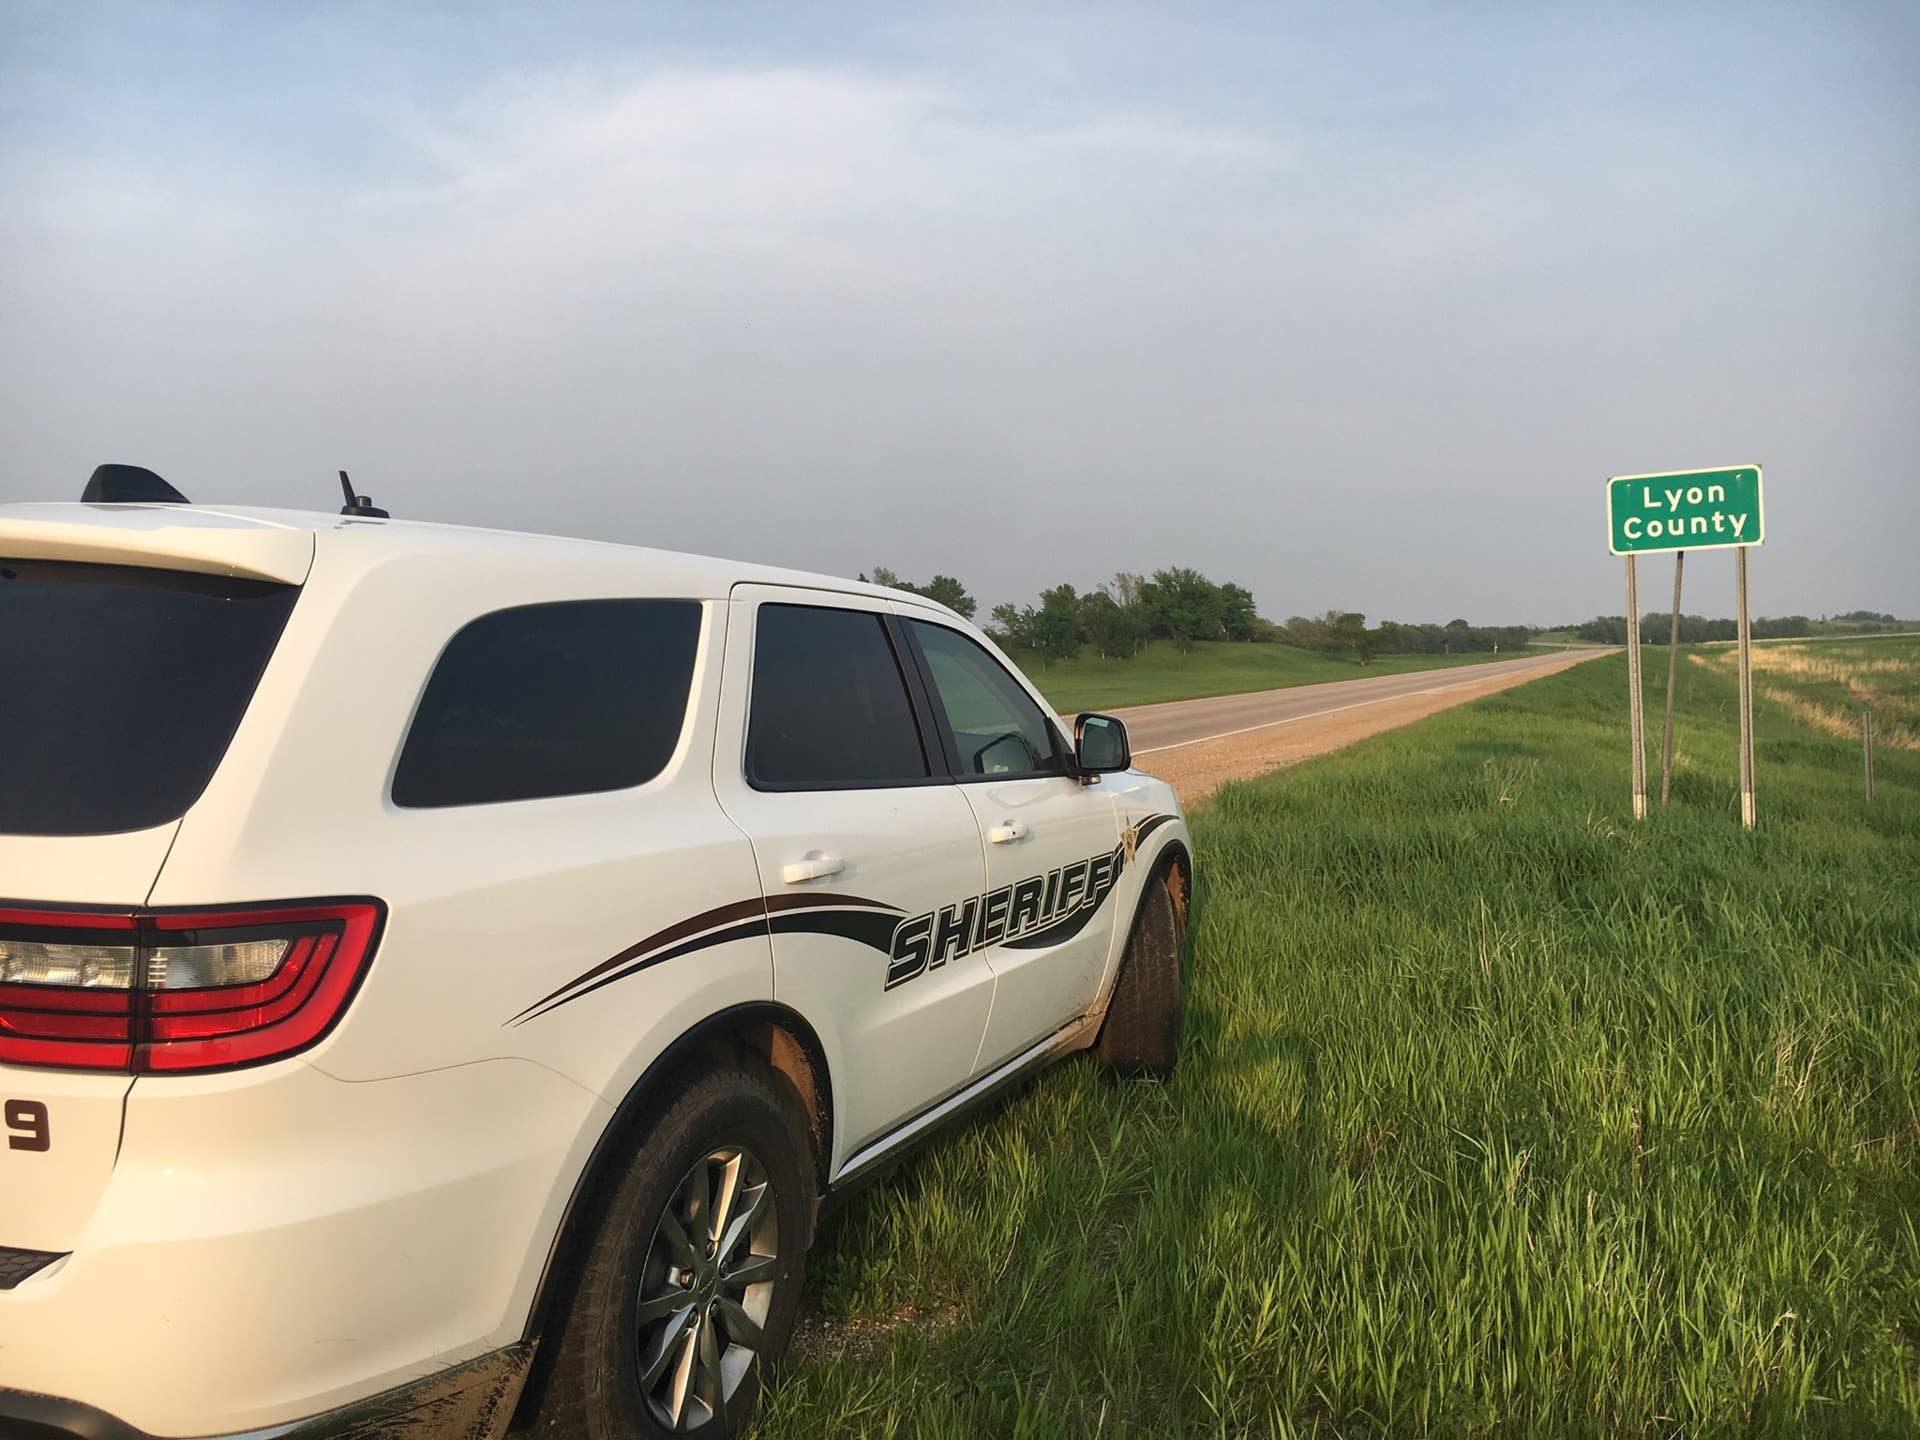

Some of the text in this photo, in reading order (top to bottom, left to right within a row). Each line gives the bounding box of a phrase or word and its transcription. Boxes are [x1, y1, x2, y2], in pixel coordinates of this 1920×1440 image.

[1643, 485, 1725, 512] Lyon
[1623, 511, 1748, 539] County
[884, 851, 1115, 992] SHERIFF
[4, 1098, 50, 1152] 9
